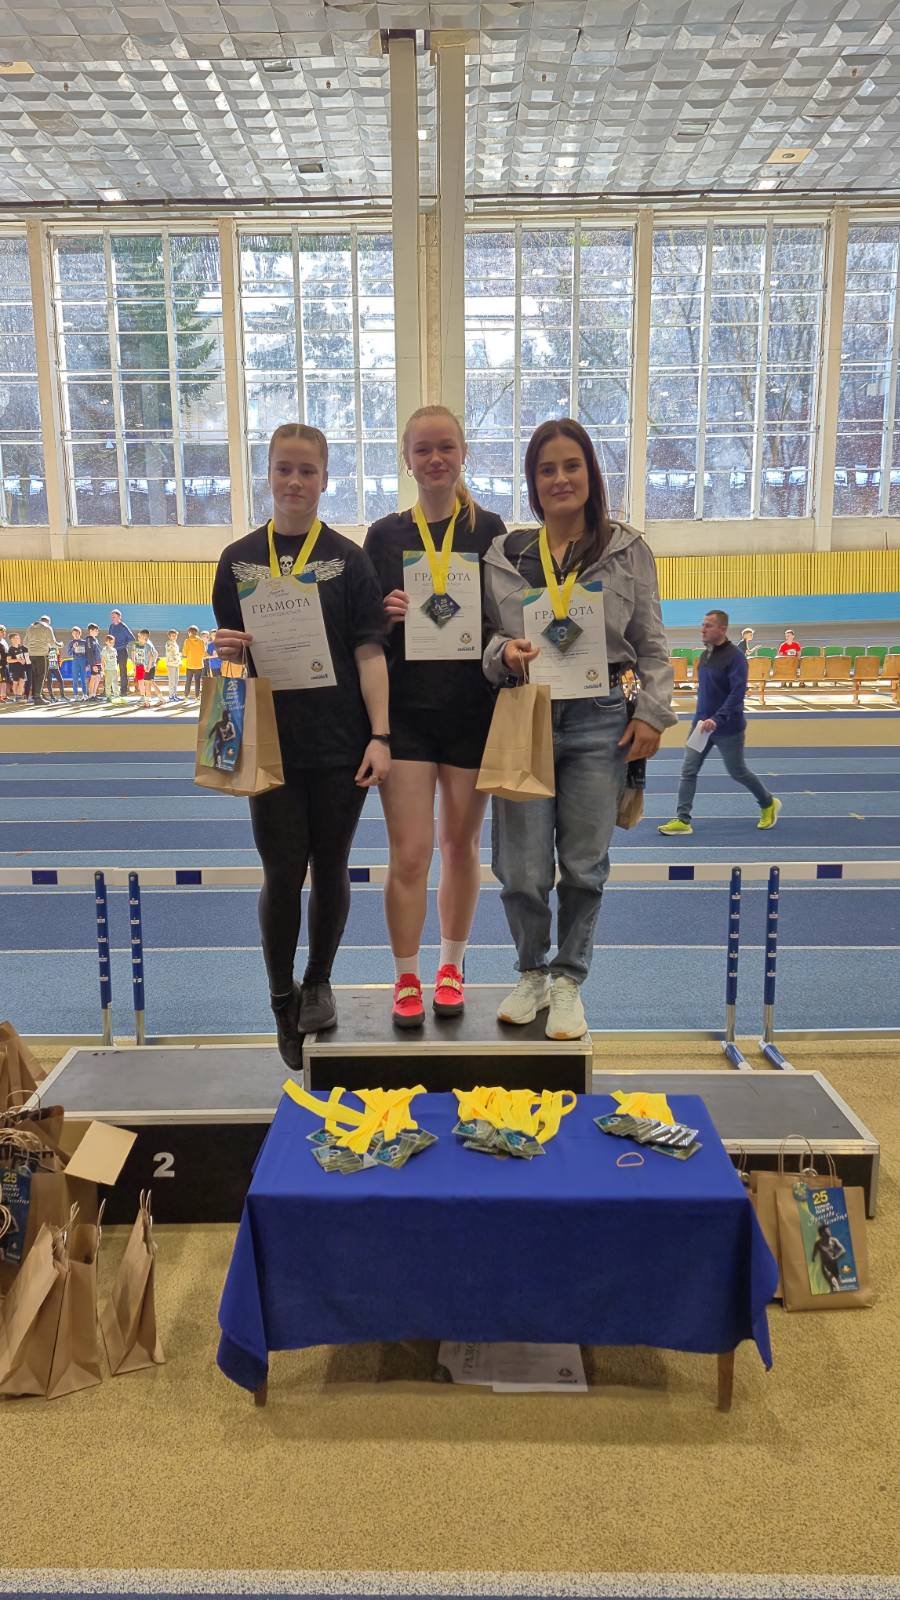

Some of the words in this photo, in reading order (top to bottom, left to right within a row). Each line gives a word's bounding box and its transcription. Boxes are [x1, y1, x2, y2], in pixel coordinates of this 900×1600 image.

[414, 572, 470, 582] ГРАОТА
[251, 597, 311, 614] ГРАМОТА
[535, 605, 594, 620] ГРАОТА
[153, 1152, 175, 1178] 2
[812, 1190, 828, 1205] 25
